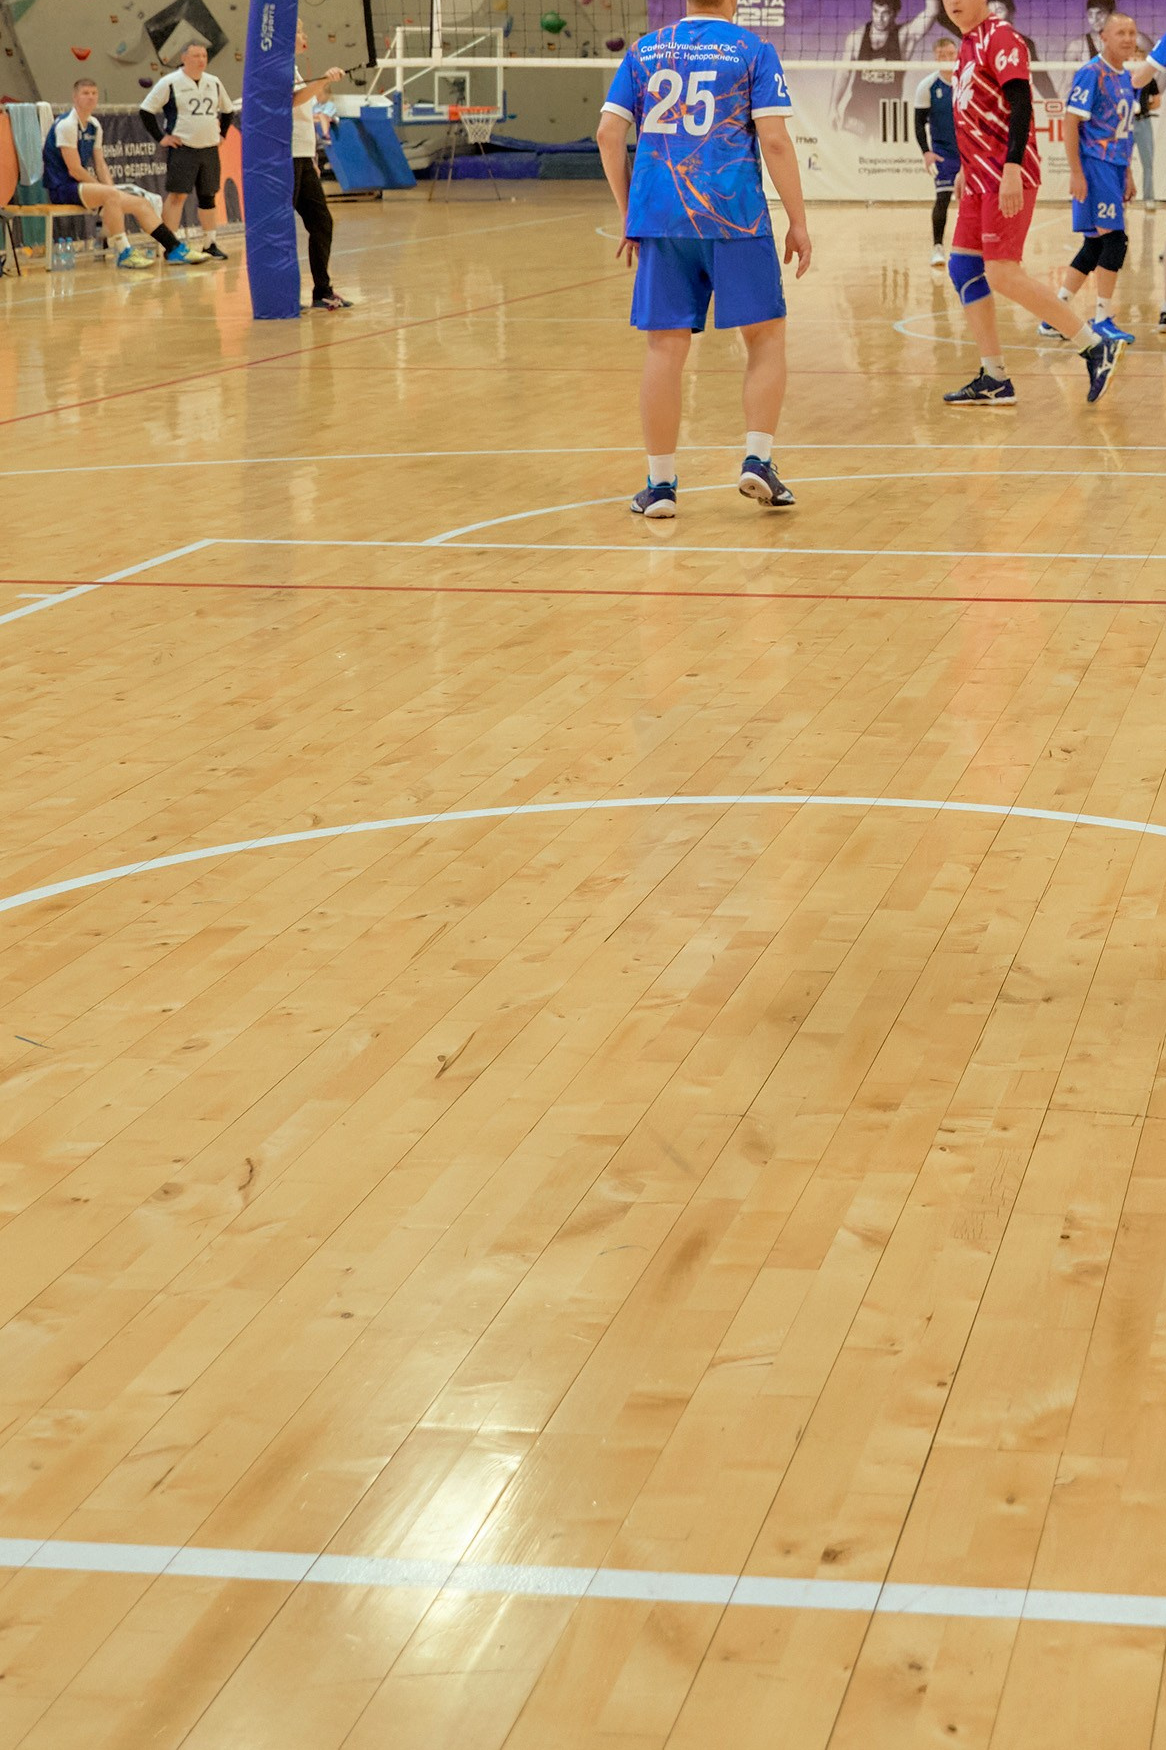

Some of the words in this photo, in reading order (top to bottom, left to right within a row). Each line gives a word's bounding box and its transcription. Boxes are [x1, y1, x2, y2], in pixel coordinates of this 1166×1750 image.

[732, 7, 785, 27] 25
[640, 41, 718, 54] Саяно-Шушенская
[719, 43, 737, 54] ГЭС
[683, 52, 740, 64] Непорожнего
[995, 47, 1020, 72] 64
[642, 68, 718, 137] 25
[1070, 86, 1090, 105] 24
[188, 97, 215, 116] 22
[124, 141, 157, 157] КЛАСТЕР
[124, 162, 168, 178] ФЕДЕРАЛЬН
[1096, 201, 1118, 220] 24
